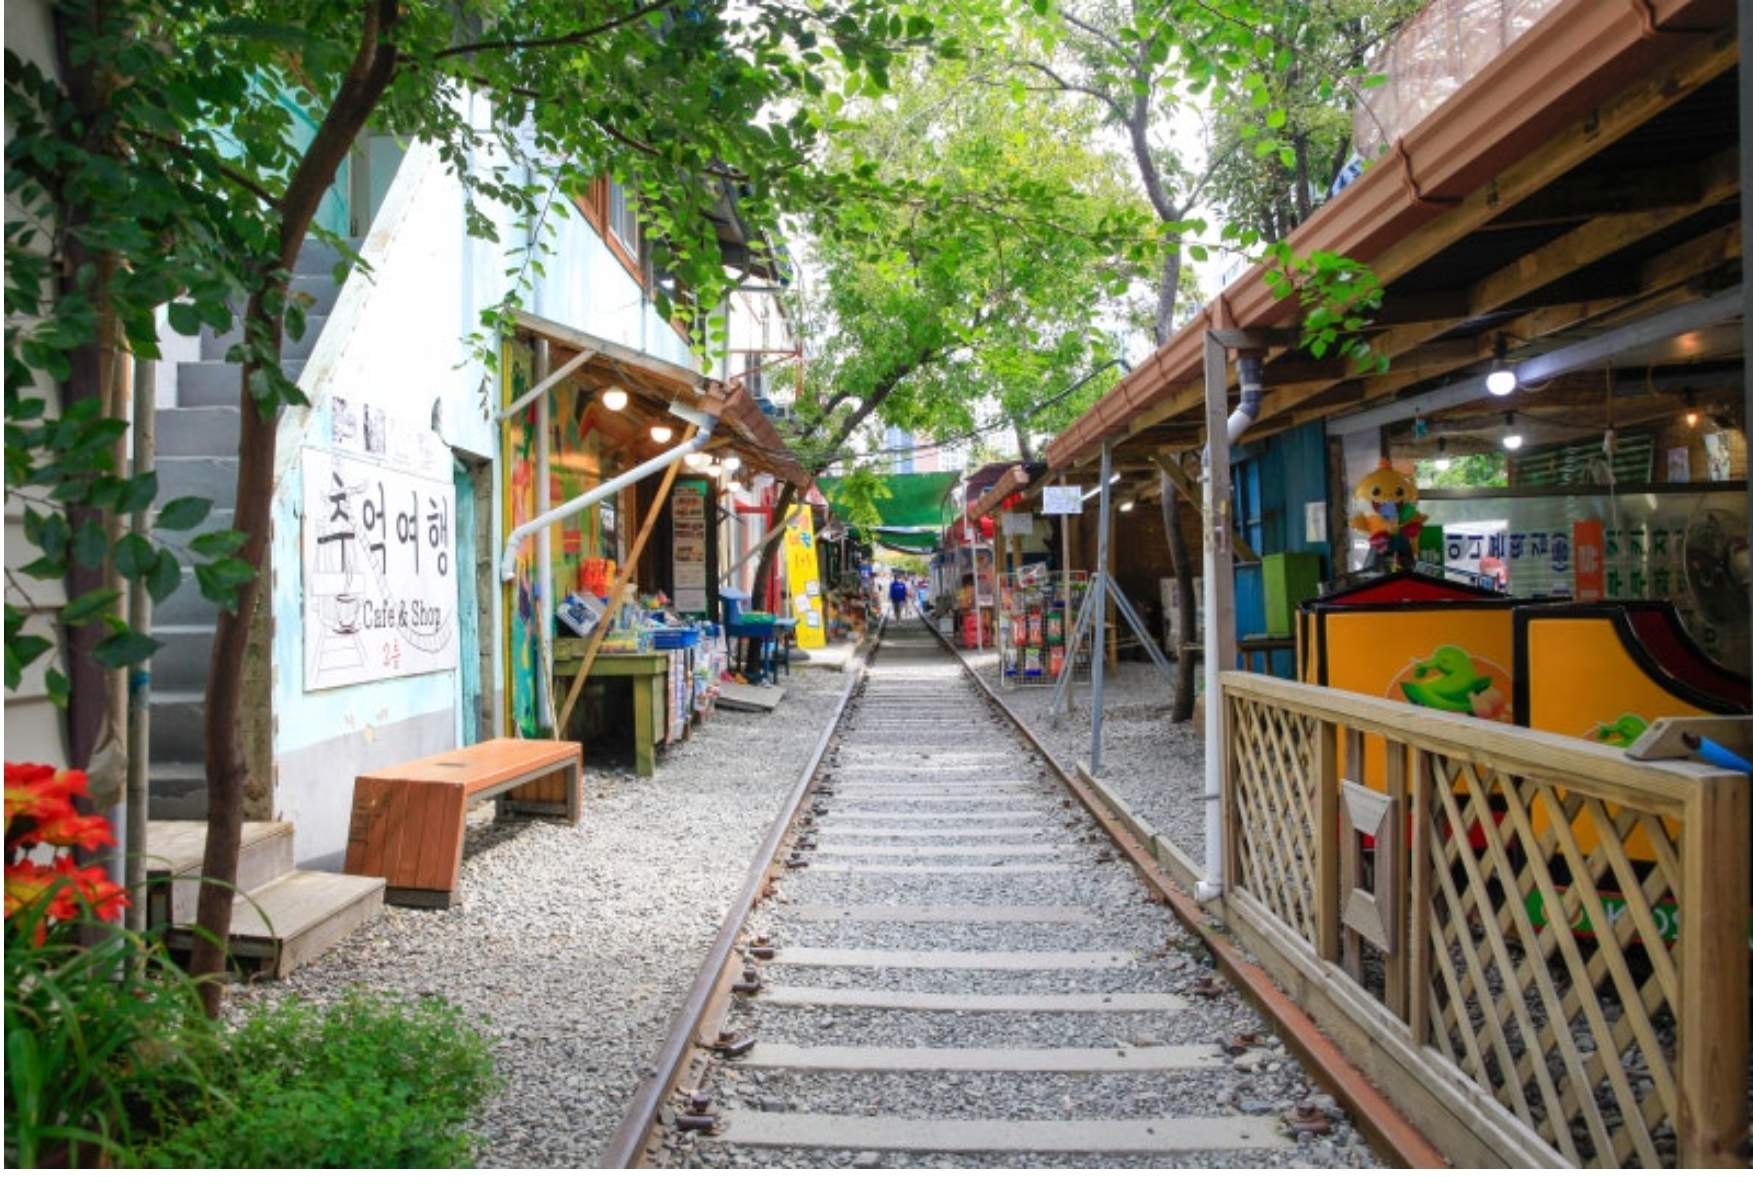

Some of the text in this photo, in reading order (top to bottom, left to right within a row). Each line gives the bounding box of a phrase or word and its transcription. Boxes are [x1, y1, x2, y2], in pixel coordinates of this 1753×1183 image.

[317, 471, 448, 577] 추억여행
[363, 599, 396, 630] Cafe
[412, 599, 441, 633] Shop
[383, 638, 401, 669] 2층
